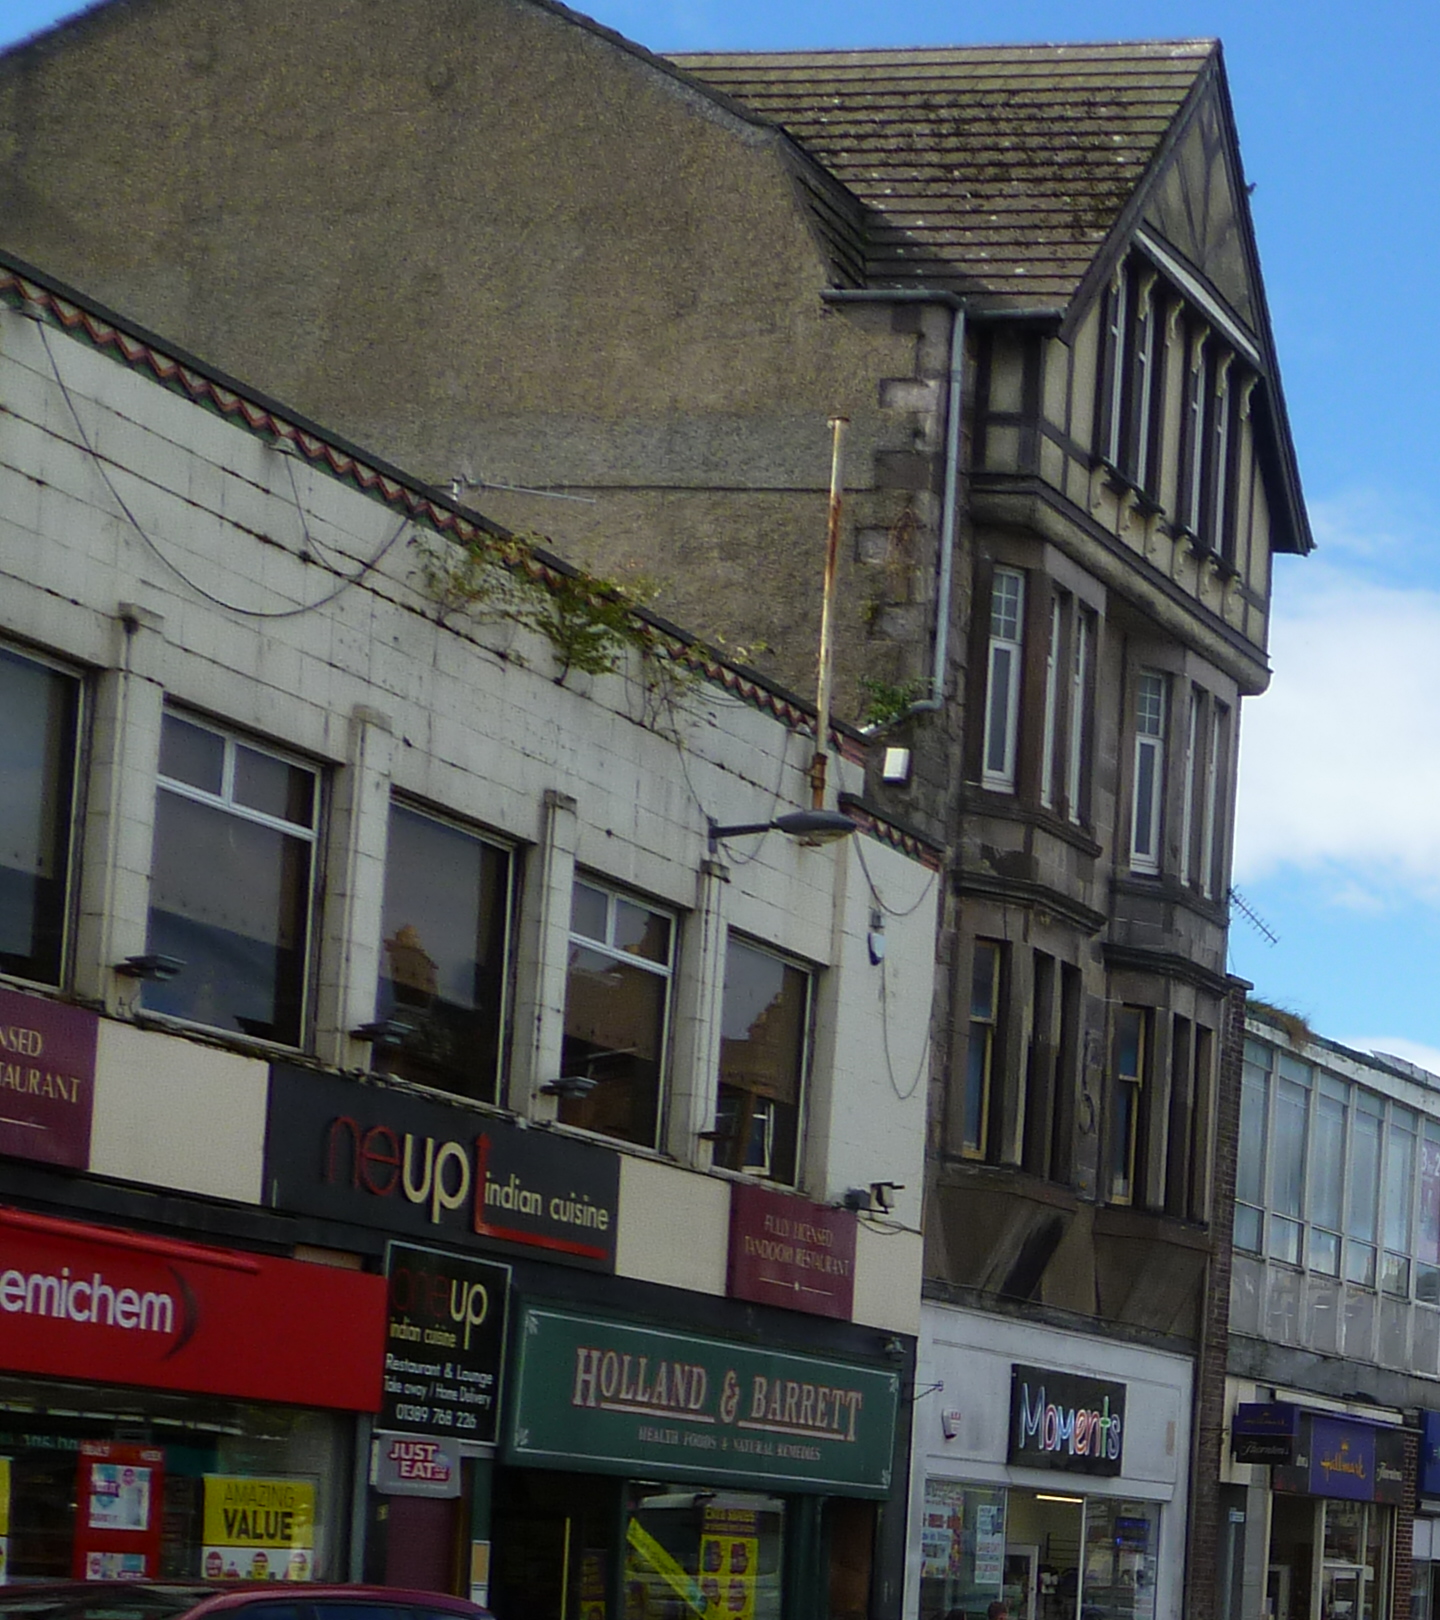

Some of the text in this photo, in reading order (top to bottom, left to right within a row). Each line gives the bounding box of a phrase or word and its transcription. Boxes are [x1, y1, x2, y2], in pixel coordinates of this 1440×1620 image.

[484, 1171, 610, 1230] indian cuisine
[386, 1352, 493, 1388] Restaurant & Lounge
[459, 1386, 492, 1410] Delivery
[572, 1348, 863, 1442] HOLLAND & BARRETT
[396, 1402, 429, 1423] 01389
[432, 1407, 453, 1426] 768
[1019, 1382, 1121, 1461] Moments
[390, 1441, 438, 1461] JUST
[638, 1426, 679, 1446] HEALTH
[683, 1431, 717, 1451] FOODS
[733, 1438, 773, 1457] NATURAL
[777, 1443, 822, 1461] REMEDIES
[400, 1460, 436, 1478] EAT
[223, 1484, 295, 1508] AMAZING
[223, 1508, 294, 1541] VALUE
